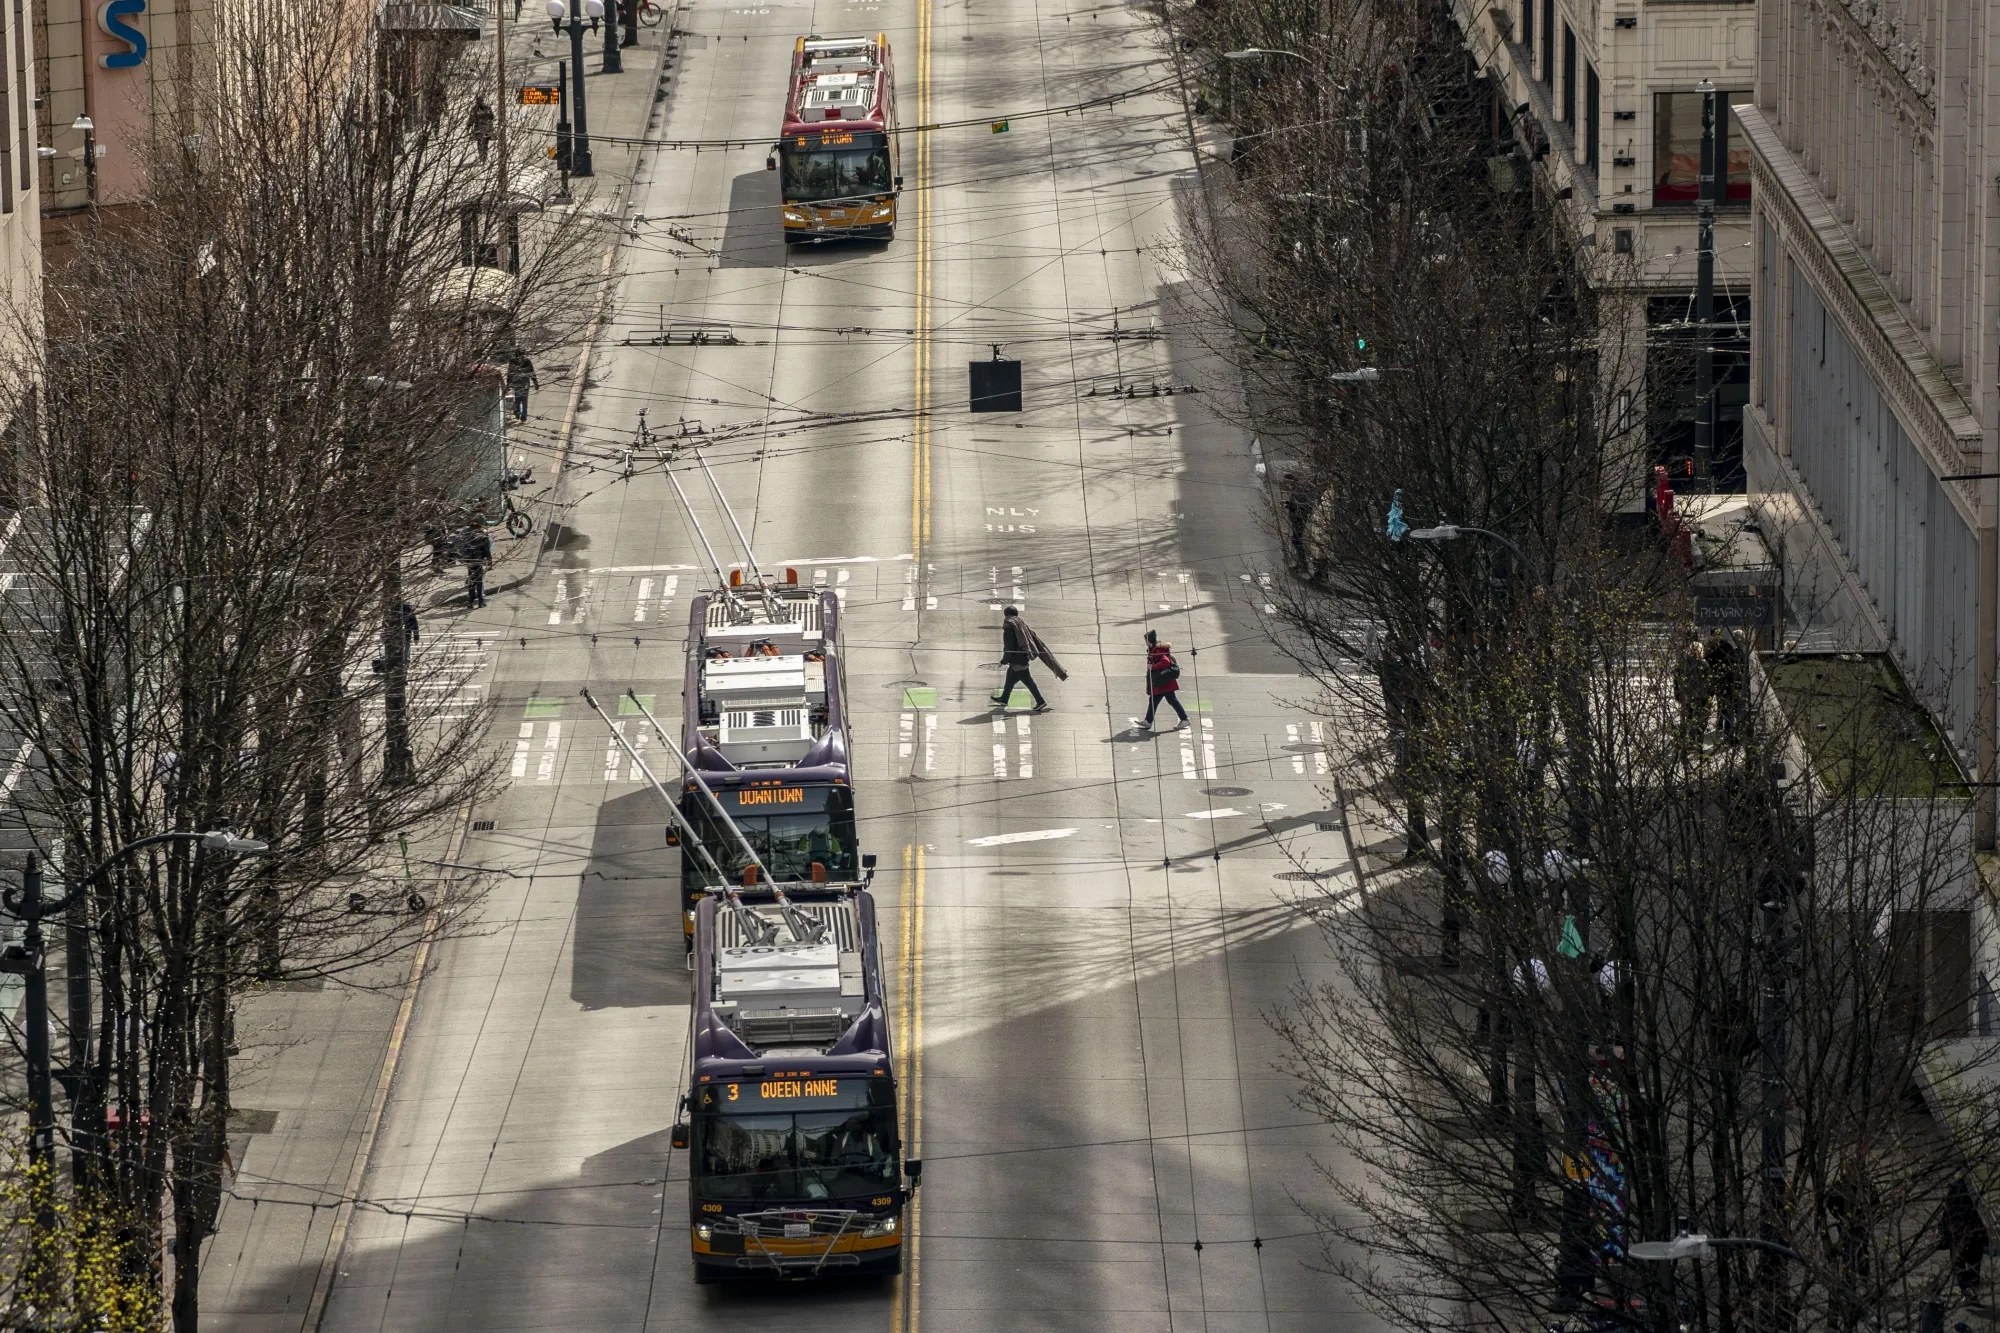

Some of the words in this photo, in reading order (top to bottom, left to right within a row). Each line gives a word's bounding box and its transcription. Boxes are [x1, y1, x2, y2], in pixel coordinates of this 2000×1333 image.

[100, 0, 147, 68] S
[1700, 606, 1766, 618] PHARMAC
[739, 788, 803, 805] DOWNTOWN
[727, 1083, 739, 1101] 3
[761, 1081, 801, 1098] QUEEN
[804, 1079, 838, 1097] ANNE
[701, 1204, 723, 1212] 4309
[872, 1197, 892, 1206] 4309
